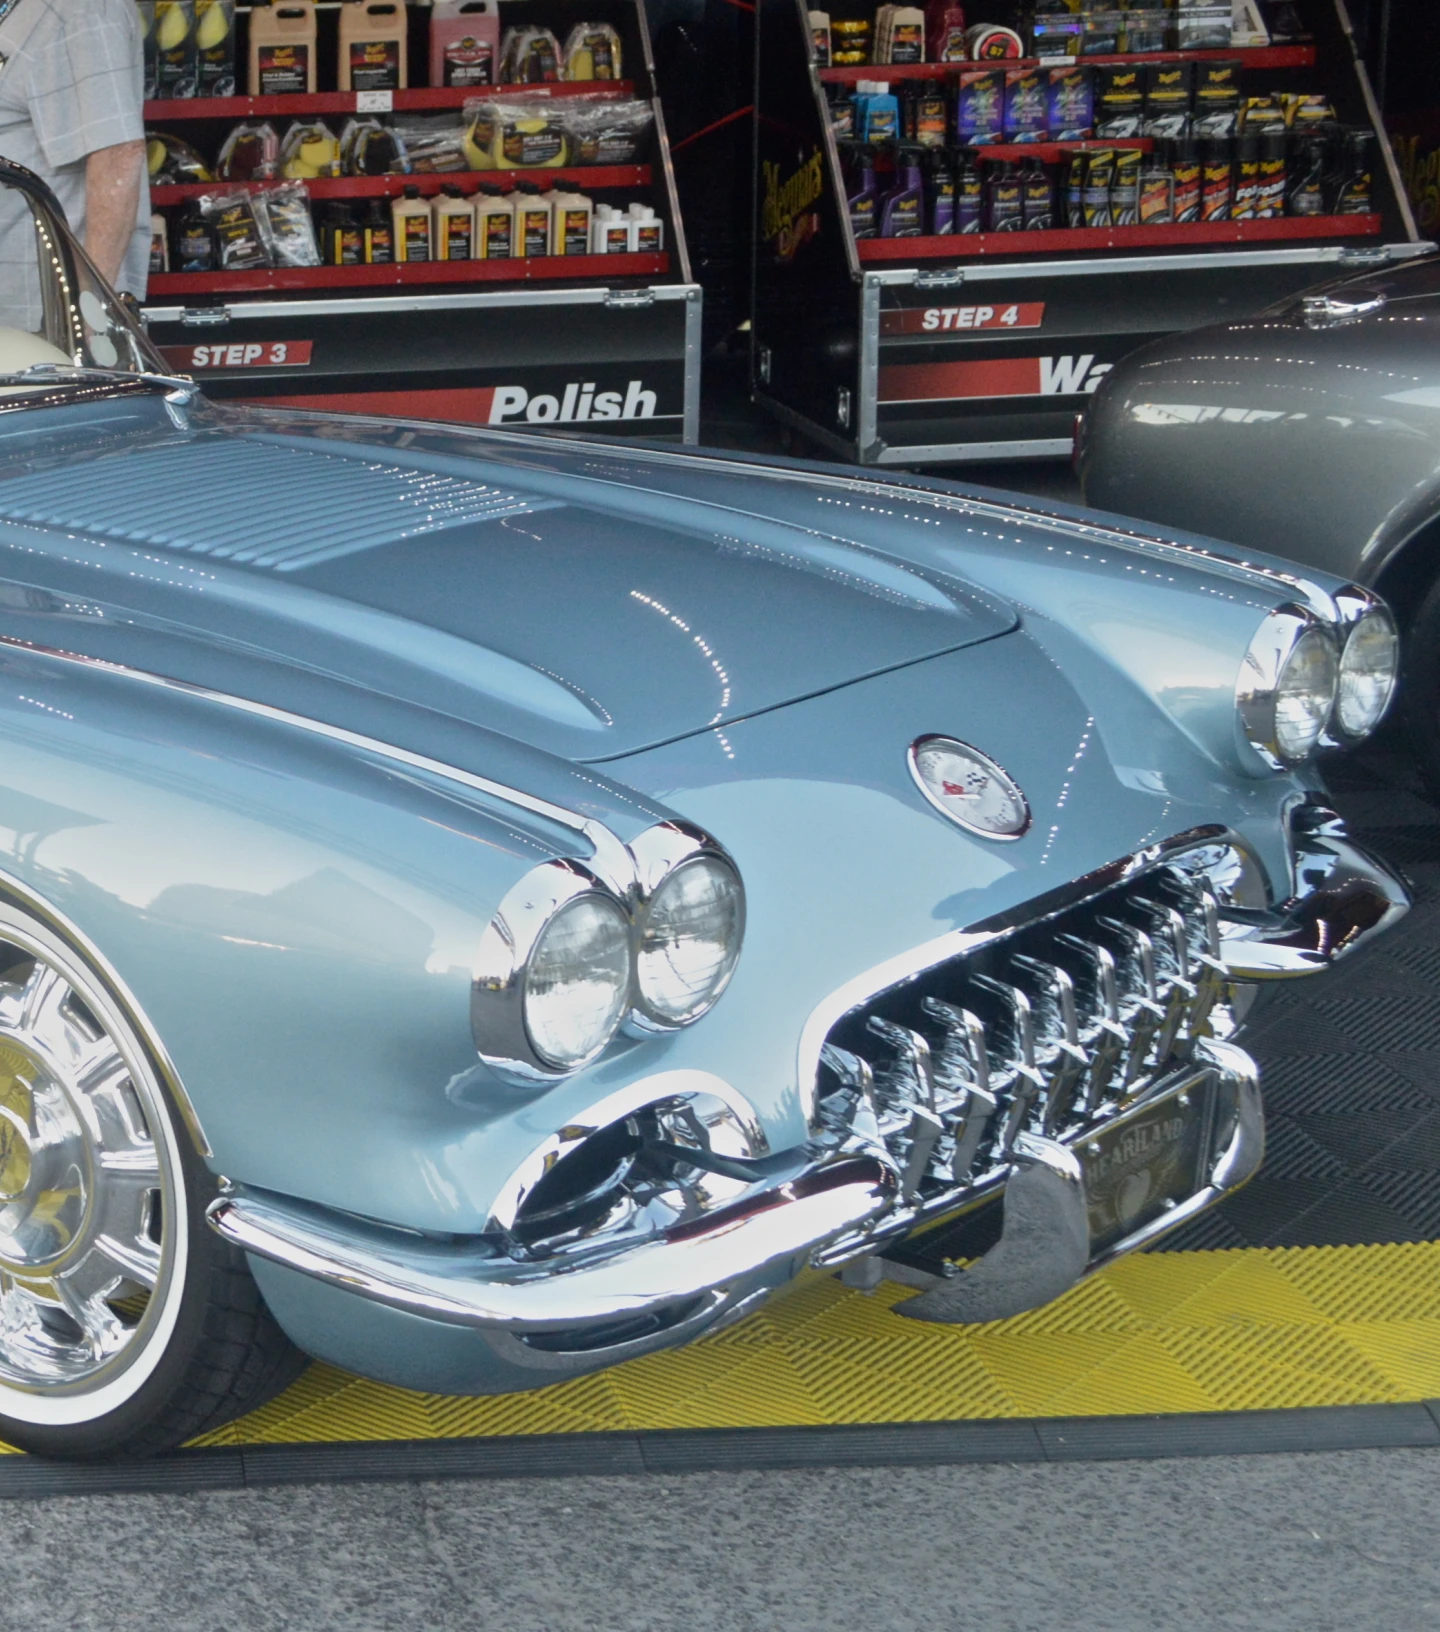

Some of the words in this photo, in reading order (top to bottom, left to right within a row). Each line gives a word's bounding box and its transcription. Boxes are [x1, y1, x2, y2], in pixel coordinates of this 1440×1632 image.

[922, 306, 994, 330] STEP
[1000, 306, 1018, 325] 4
[192, 344, 262, 367] STEP
[268, 343, 287, 363] 3
[488, 380, 657, 425] Polish
